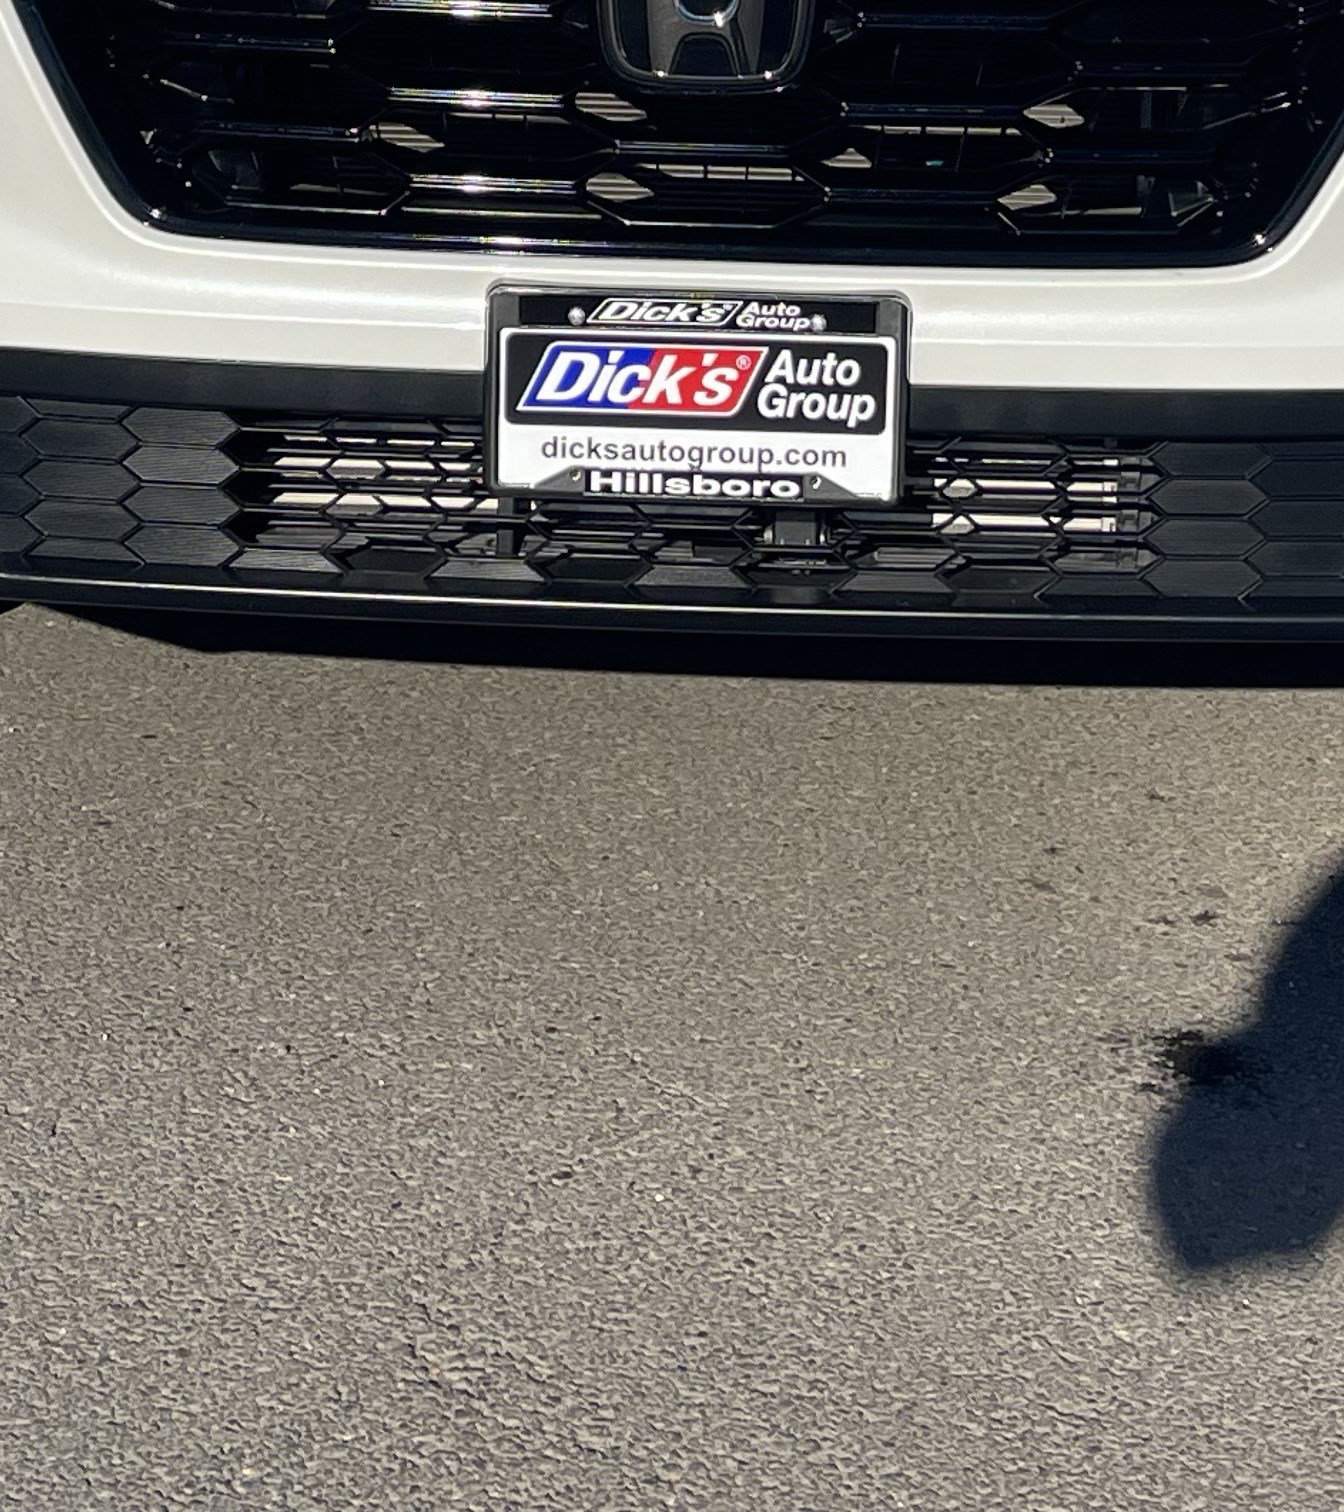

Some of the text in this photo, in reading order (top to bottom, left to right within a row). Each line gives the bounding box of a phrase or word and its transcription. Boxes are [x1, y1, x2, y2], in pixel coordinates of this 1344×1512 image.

[597, 300, 802, 324] Dick's Auto
[736, 313, 812, 331] Group
[536, 349, 861, 408] Dick's Auto
[757, 383, 876, 429] Group
[541, 436, 847, 472] dicksautogroup.com
[589, 470, 801, 498] Hillsboro
